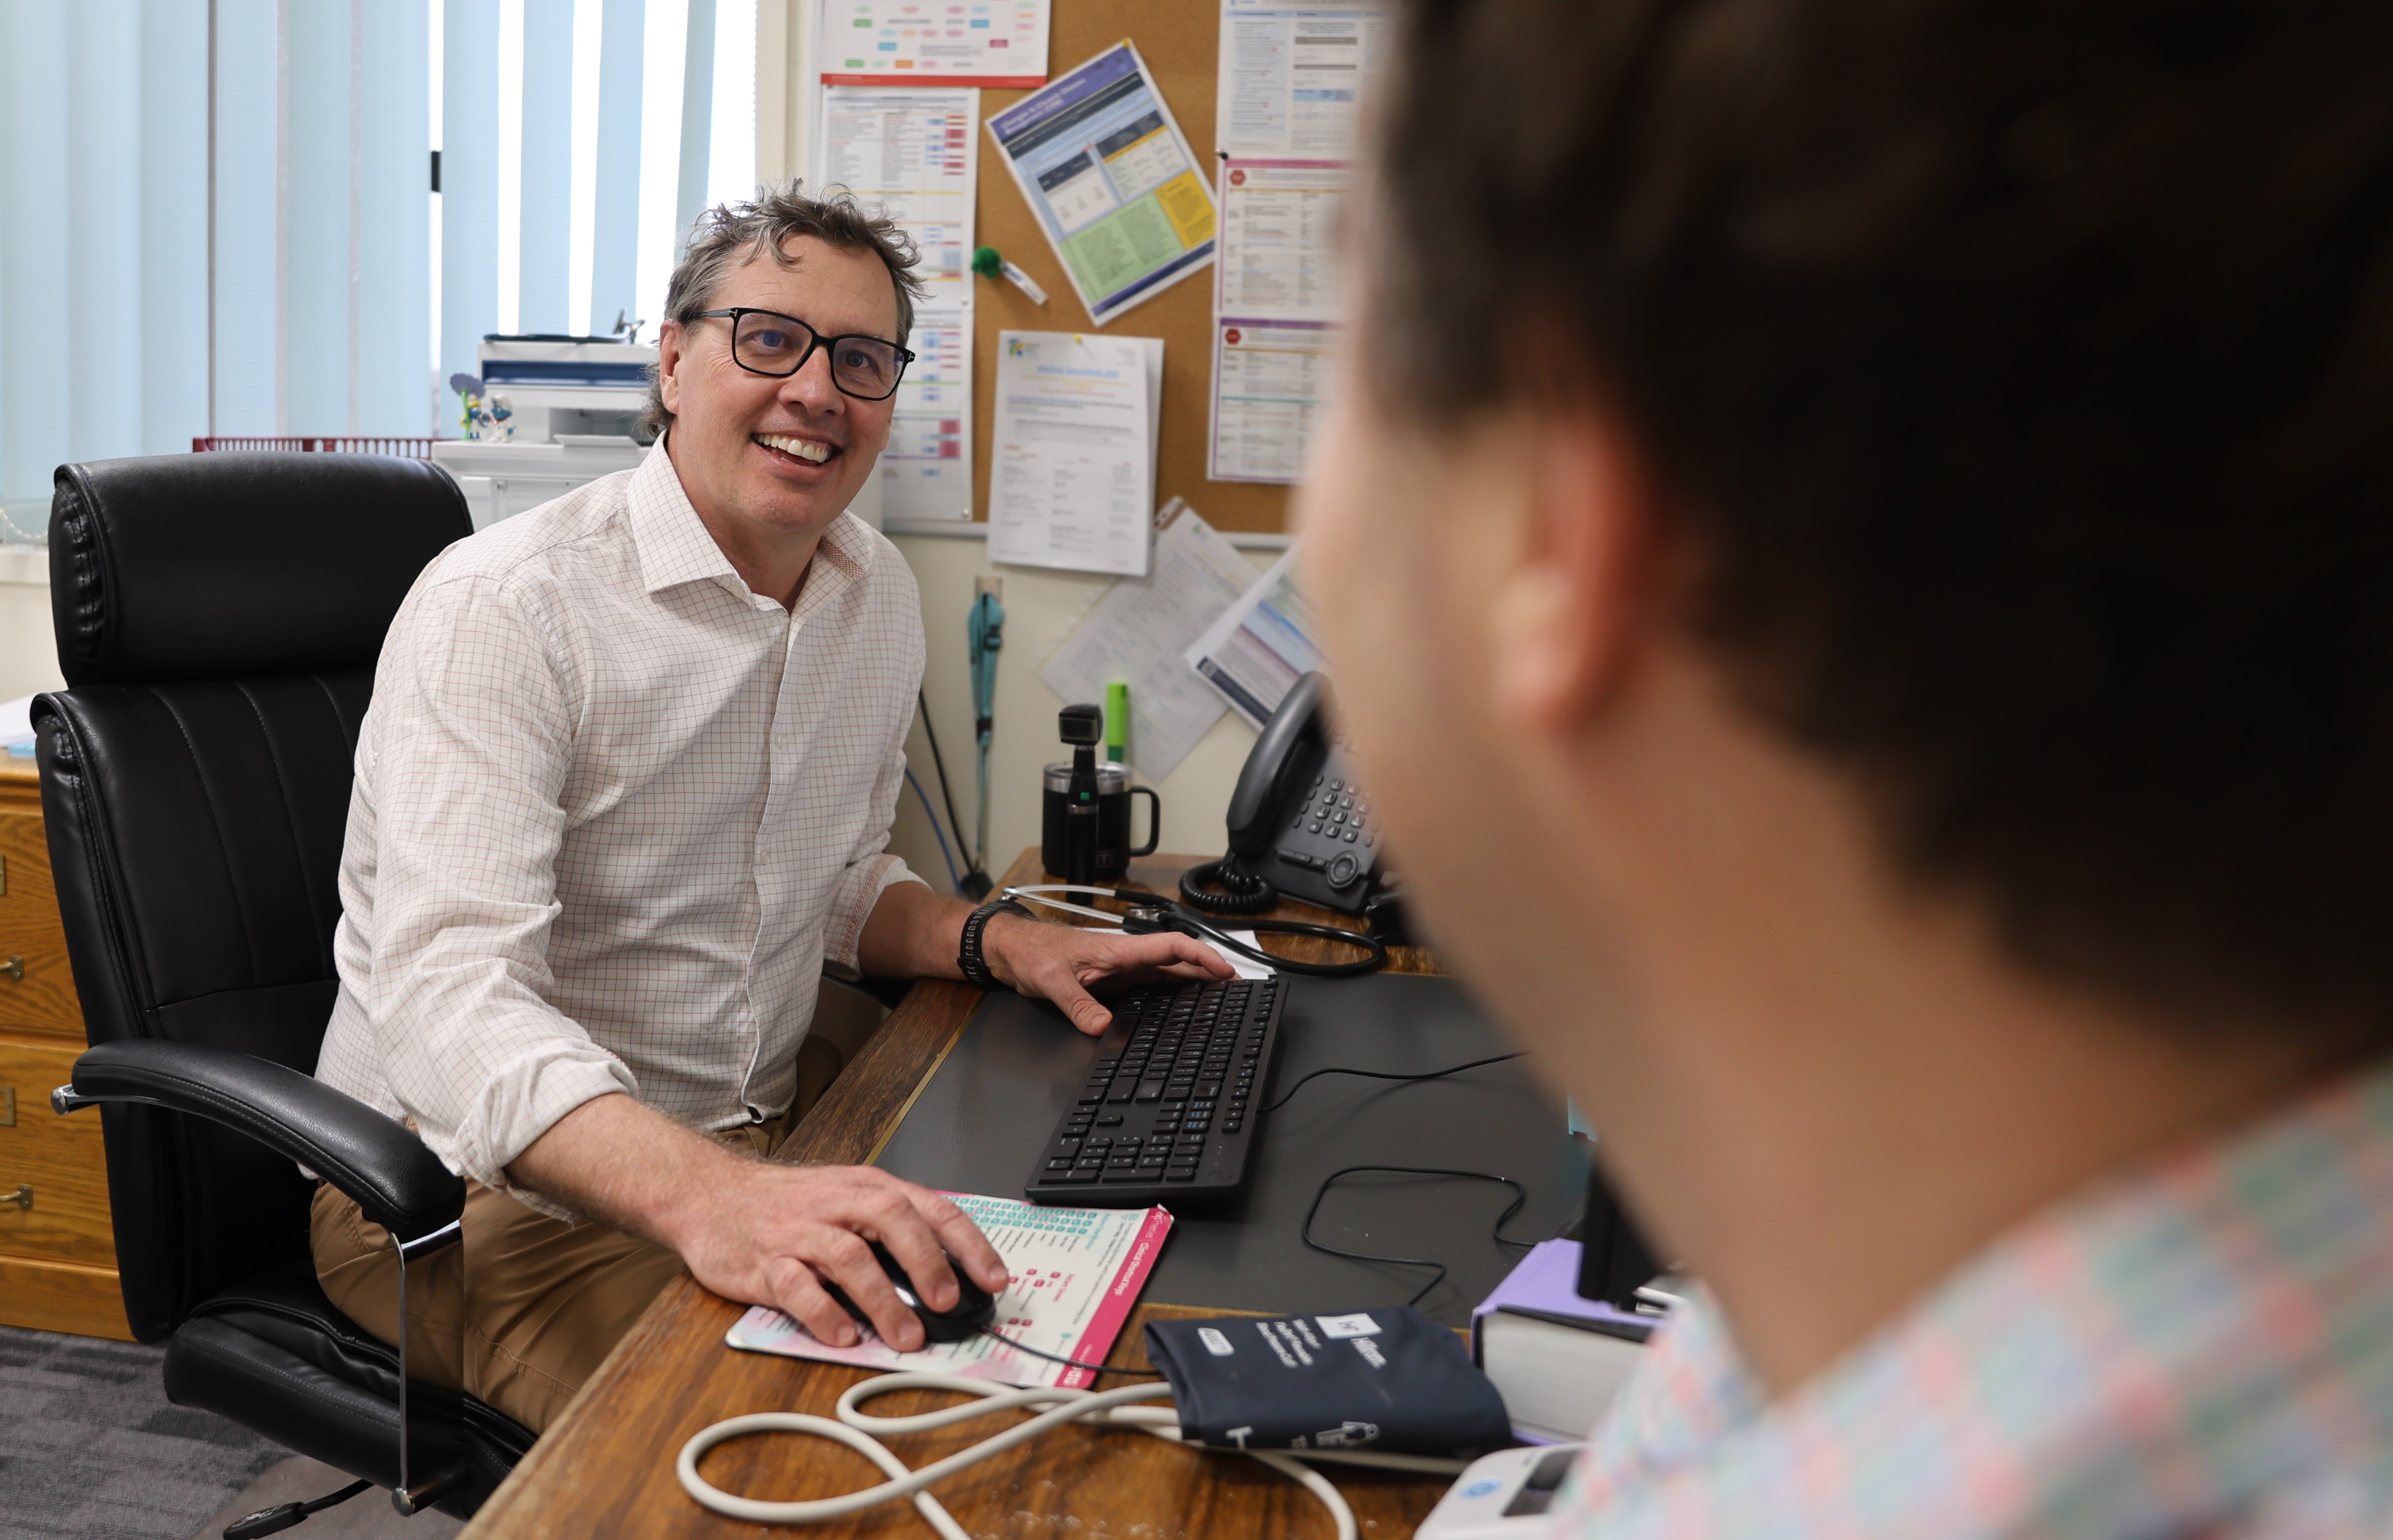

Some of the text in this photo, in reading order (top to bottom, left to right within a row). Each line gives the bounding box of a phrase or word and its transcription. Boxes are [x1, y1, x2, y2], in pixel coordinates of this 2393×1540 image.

[1095, 854, 1112, 864] ETI
[1114, 1243, 1149, 1295] Clinical Shortcut Keys
